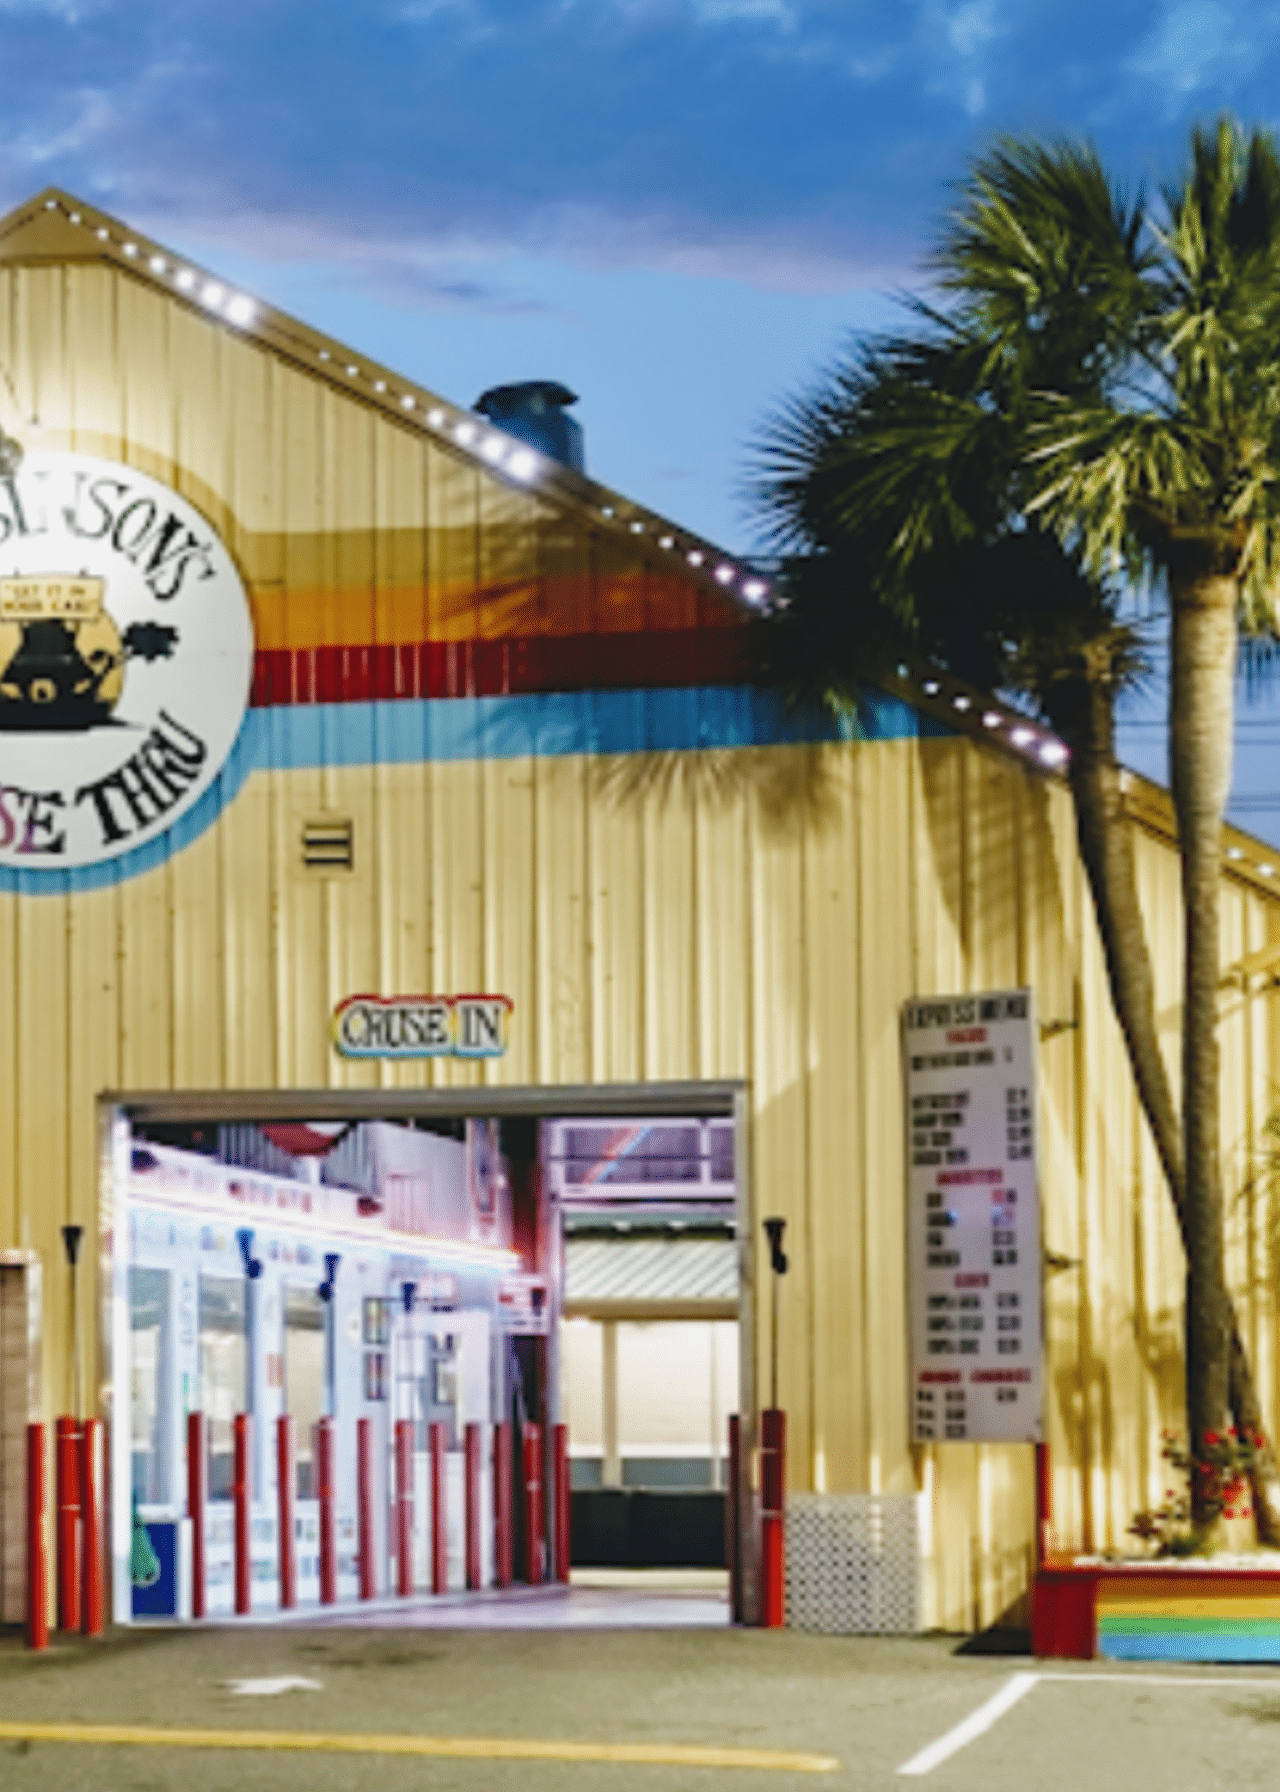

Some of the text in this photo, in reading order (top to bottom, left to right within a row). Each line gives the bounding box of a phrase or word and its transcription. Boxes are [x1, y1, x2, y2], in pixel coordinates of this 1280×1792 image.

[77, 708, 208, 847] THRU
[342, 1004, 501, 1048] CRUSE IN
